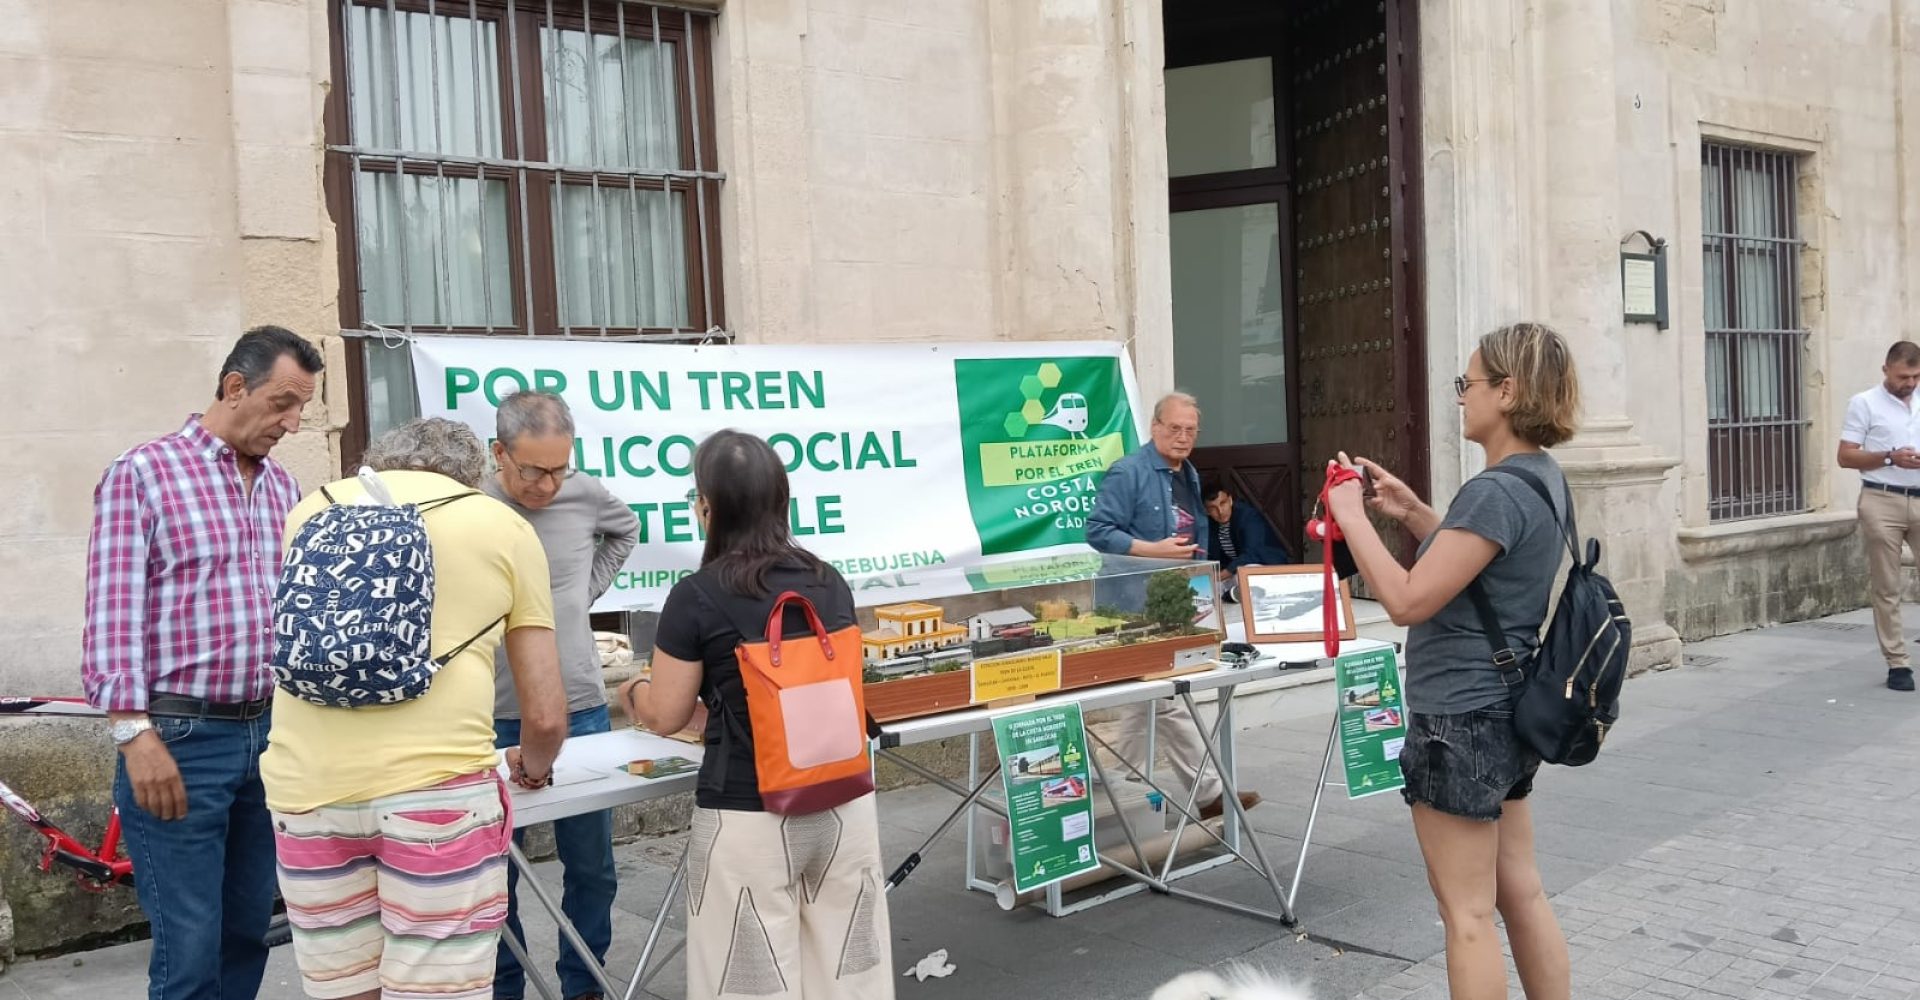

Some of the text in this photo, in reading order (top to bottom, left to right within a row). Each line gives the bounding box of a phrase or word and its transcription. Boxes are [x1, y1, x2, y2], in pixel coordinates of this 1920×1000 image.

[589, 370, 671, 411] UN
[687, 370, 826, 411] TREN
[766, 430, 918, 474] OCIAL
[1010, 443, 1100, 459] PLATAFORMA
[1016, 457, 1103, 480] POR EL TREN
[1027, 476, 1096, 500] COSTA
[831, 549, 945, 575] REBUJENA
